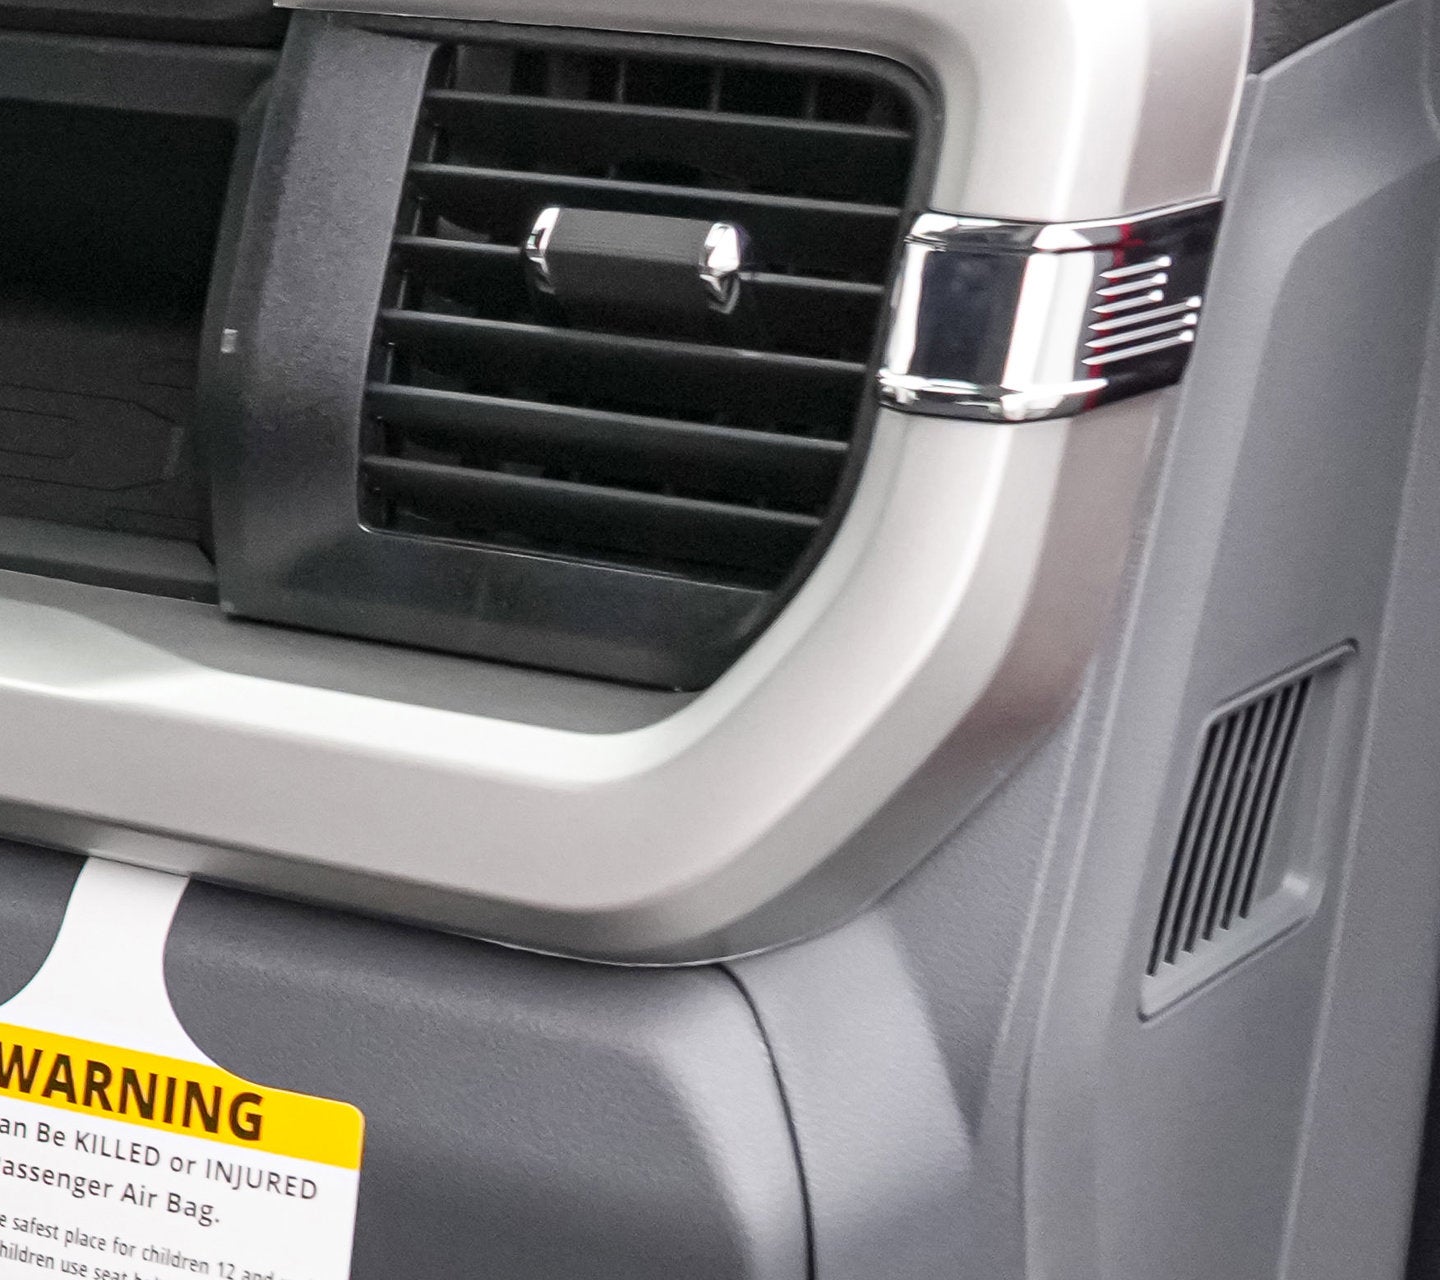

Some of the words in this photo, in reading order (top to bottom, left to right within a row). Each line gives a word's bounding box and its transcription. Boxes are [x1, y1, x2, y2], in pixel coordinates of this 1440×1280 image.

[36, 1121, 66, 1147] Be
[74, 1129, 161, 1168] KILLED
[169, 1155, 197, 1175] or
[206, 1158, 318, 1201] INJURED
[120, 1182, 158, 1209] Air
[166, 1192, 220, 1227] Bag.
[12, 1214, 60, 1241] safest
[64, 1226, 107, 1252] place
[112, 1235, 137, 1258] for
[141, 1244, 210, 1275] children
[217, 1261, 236, 1280] 12
[60, 1257, 88, 1278] use
